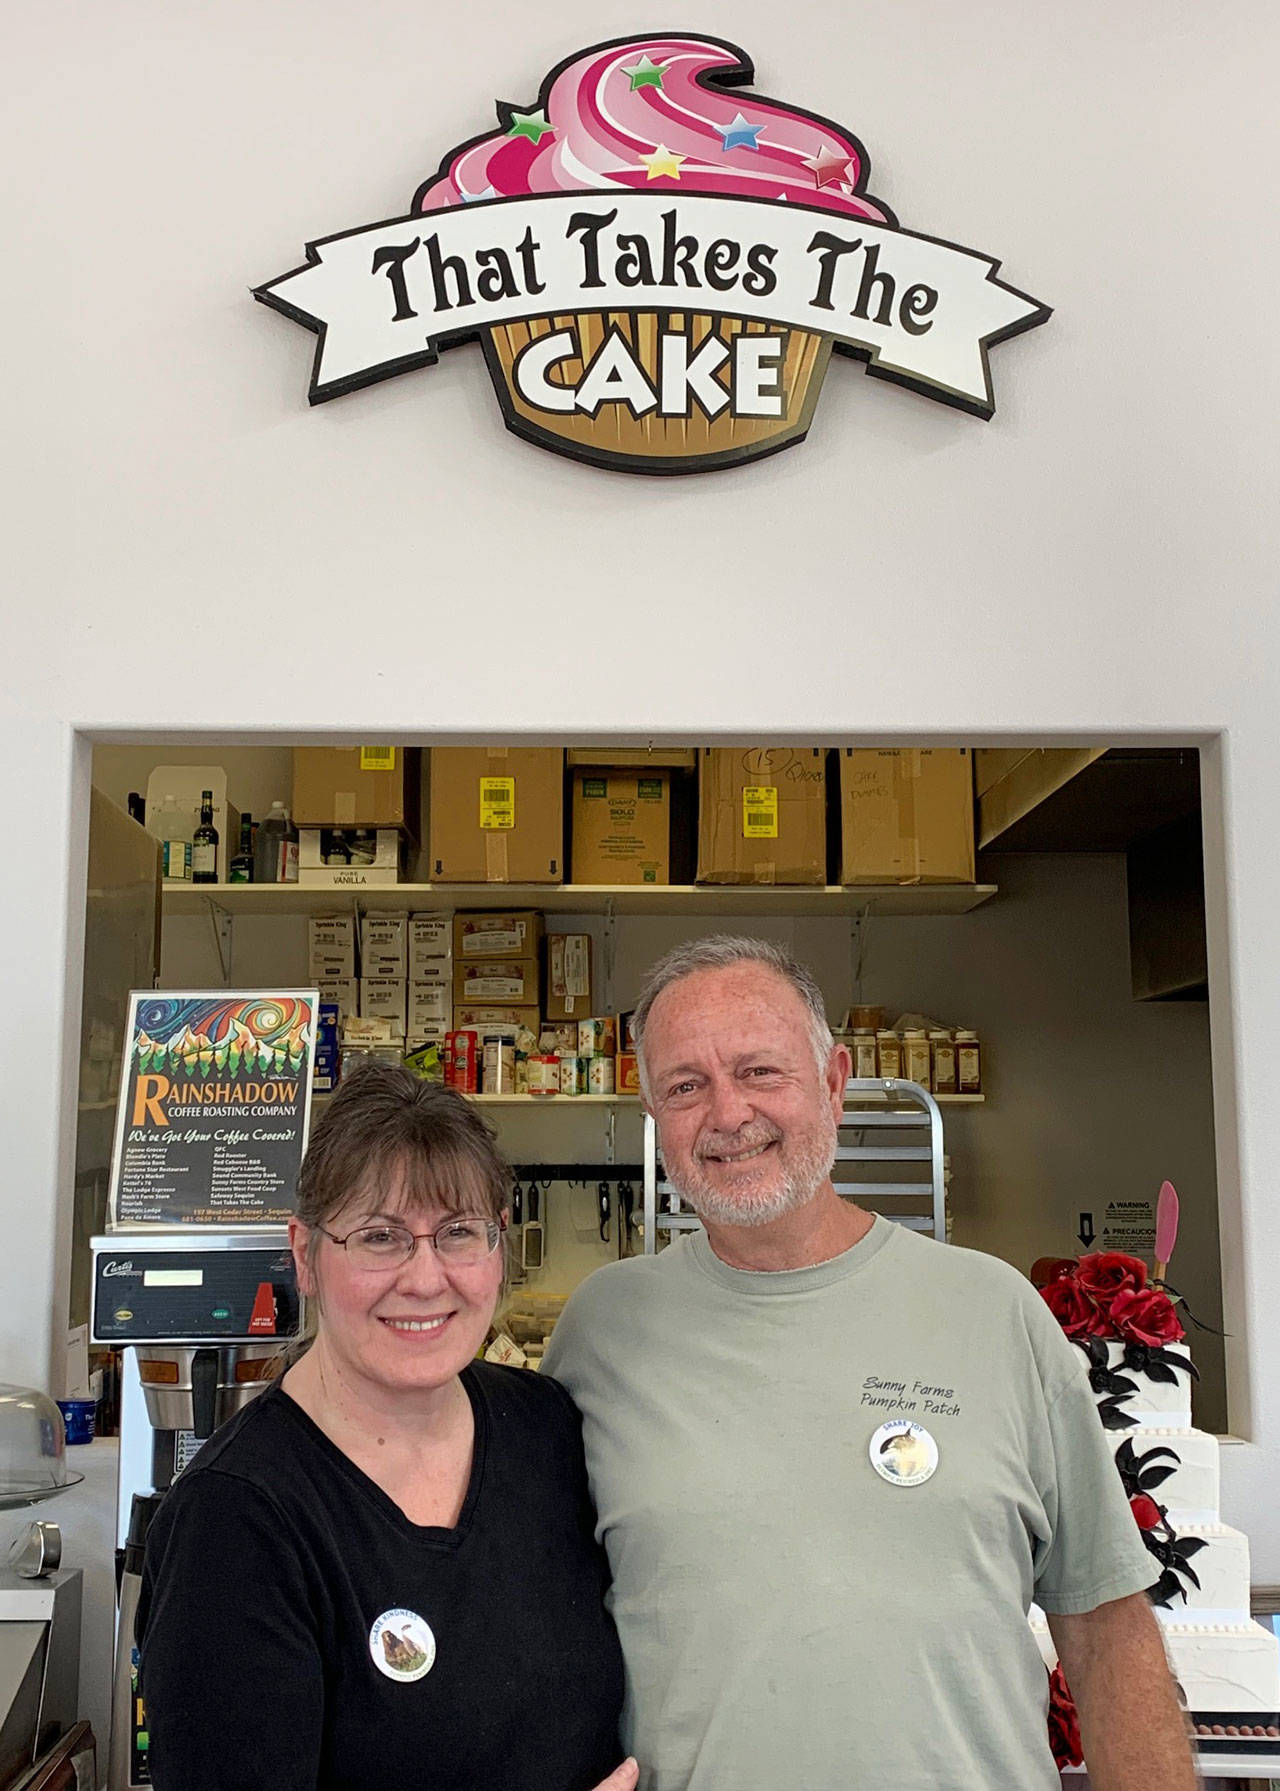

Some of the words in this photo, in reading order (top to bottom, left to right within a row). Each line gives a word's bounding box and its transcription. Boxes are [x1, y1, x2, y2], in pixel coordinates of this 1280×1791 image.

[371, 232, 547, 323] That
[565, 208, 778, 296] Takes
[806, 227, 939, 337] The
[519, 331, 783, 418] CAKE
[333, 876, 367, 884] VANILLA
[132, 1074, 299, 1127] RAINSHADOW
[168, 1106, 202, 1117] COFFEE
[202, 1106, 250, 1117] ROASTING
[251, 1105, 298, 1116] COMPANY
[128, 1130, 160, 1142] We've
[161, 1130, 182, 1144] Got
[183, 1130, 211, 1144] Your
[213, 1129, 249, 1145] Coffee
[252, 1129, 296, 1141] Covered!
[862, 1376, 907, 1397] Sunny
[912, 1381, 955, 1399] Farms
[860, 1392, 917, 1412] Pumpkin
[923, 1399, 961, 1416] Patch
[882, 1420, 908, 1431] SHARE
